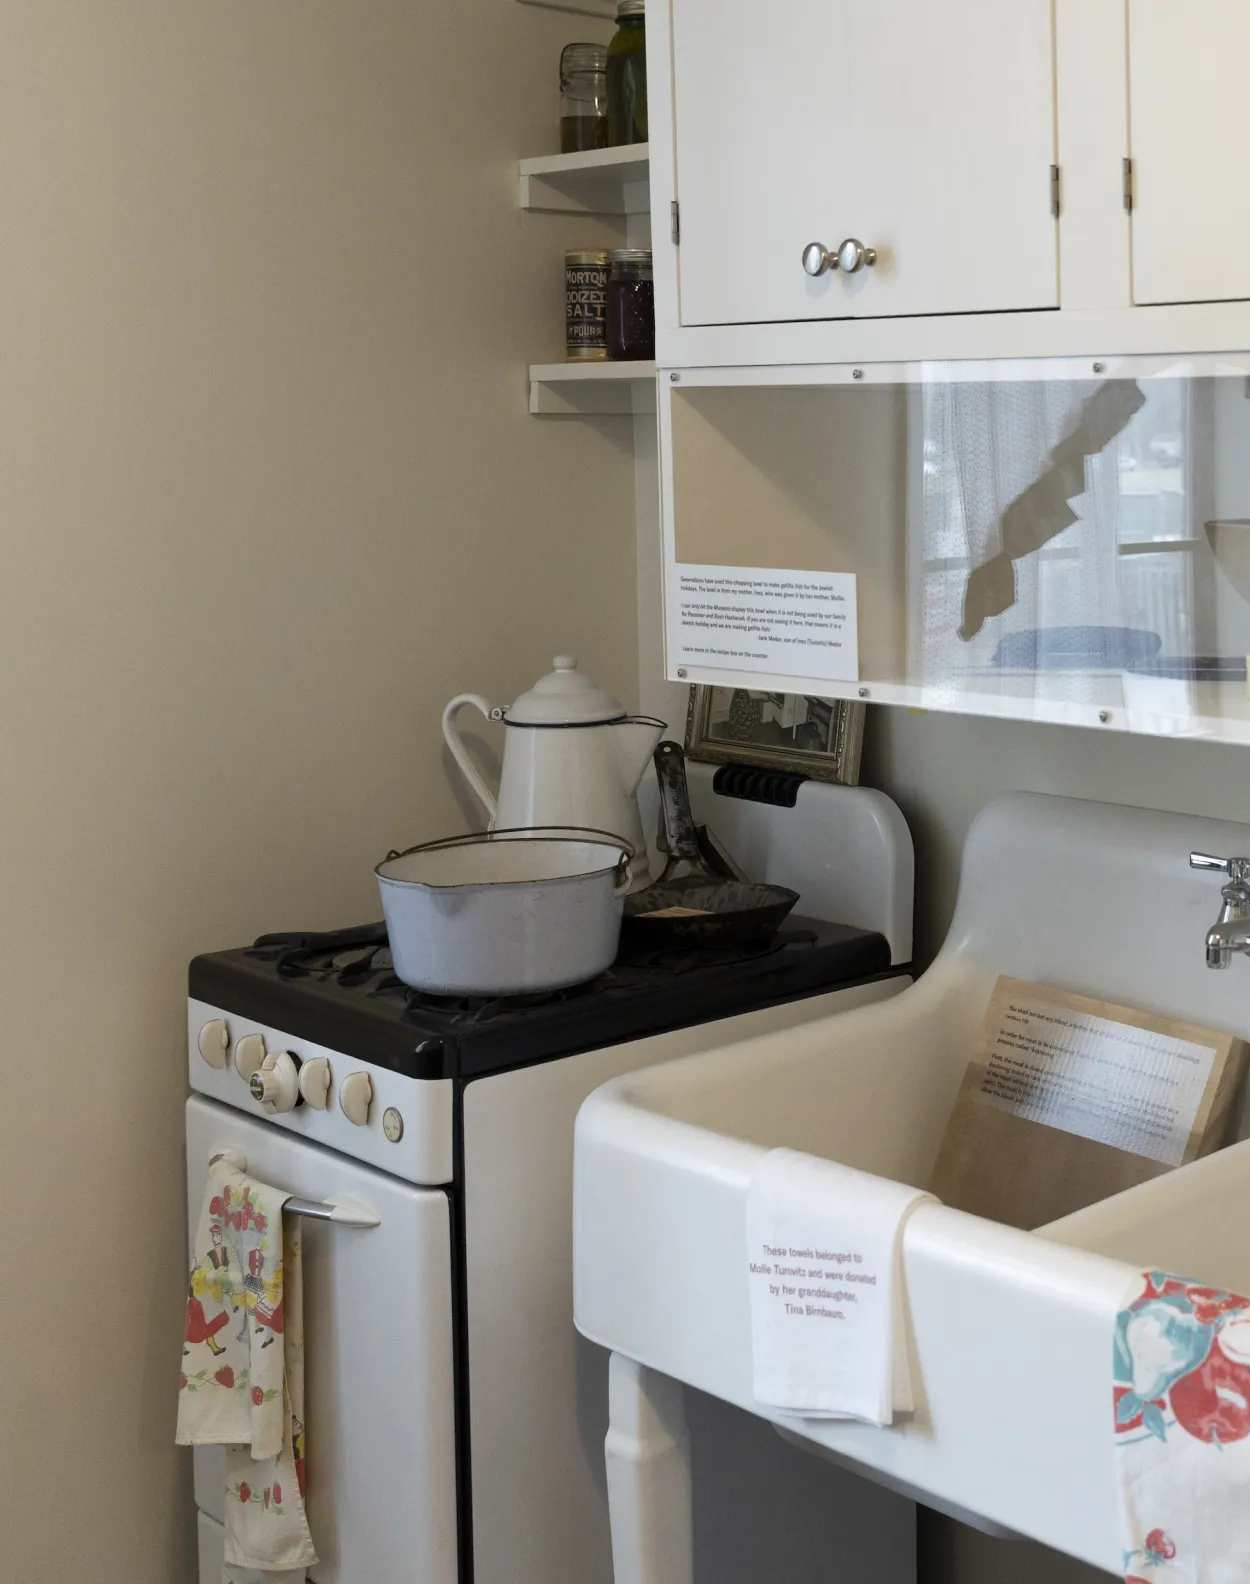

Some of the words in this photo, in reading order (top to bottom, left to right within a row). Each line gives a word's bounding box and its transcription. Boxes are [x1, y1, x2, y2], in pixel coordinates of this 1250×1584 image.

[565, 270, 606, 286] MORTON
[566, 304, 604, 316] SALT
[573, 325, 602, 336] POURS
[997, 1038, 1015, 1047] process
[988, 1062, 1011, 1072] kashering
[762, 1244, 787, 1256] These
[789, 1247, 814, 1259] towels
[815, 1250, 852, 1264] belonged
[853, 1253, 862, 1263] to
[750, 1263, 772, 1275] Mollie
[774, 1265, 806, 1277] Turovitz
[808, 1268, 822, 1278] and
[825, 1272, 843, 1280] were
[845, 1272, 876, 1285] donated
[770, 1284, 780, 1296] by
[782, 1284, 796, 1295] her
[798, 1287, 858, 1303] granddaughter,
[784, 1303, 804, 1315] Tina
[806, 1305, 846, 1320] Birnbaum.
